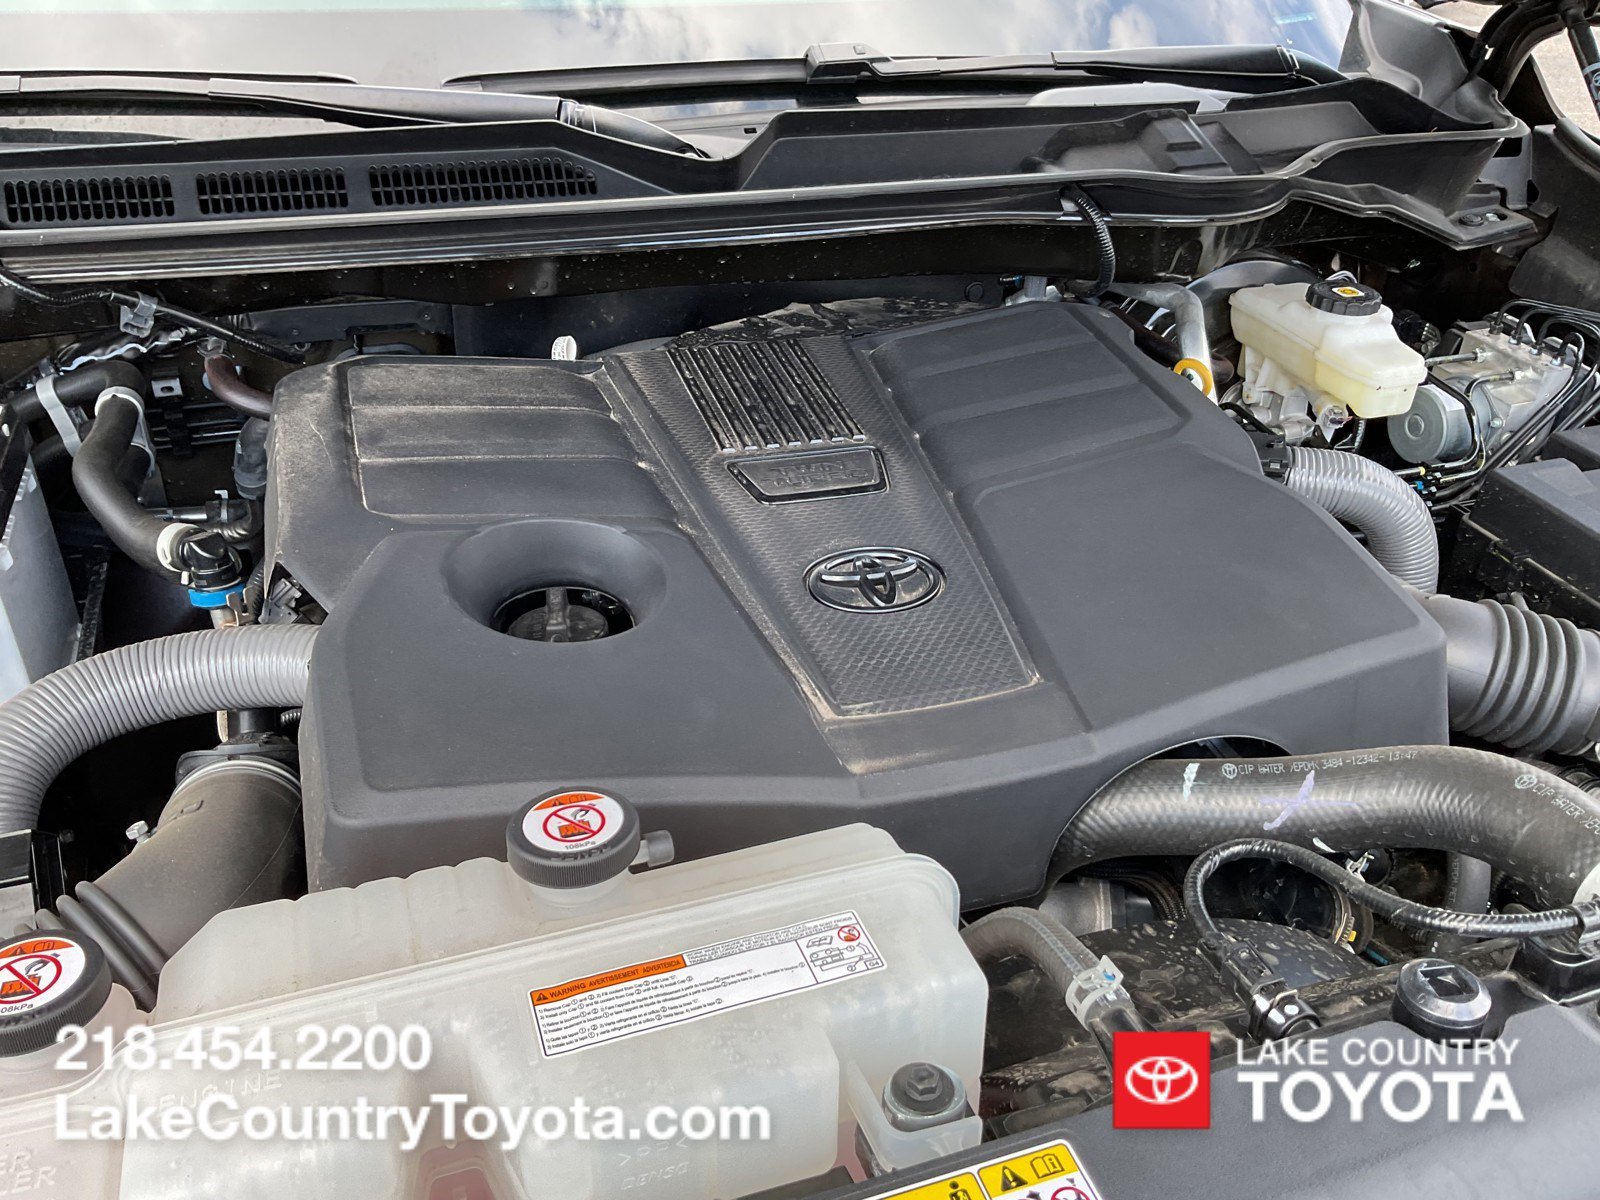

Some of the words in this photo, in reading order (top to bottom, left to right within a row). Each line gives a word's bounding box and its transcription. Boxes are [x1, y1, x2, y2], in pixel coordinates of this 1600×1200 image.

[1238, 765, 1254, 776] CIP
[565, 841, 596, 850] 108kPa
[549, 982, 587, 998] WARNING
[588, 969, 640, 987] AVERTISSEMENT
[641, 959, 681, 974] ADVERTENCIA
